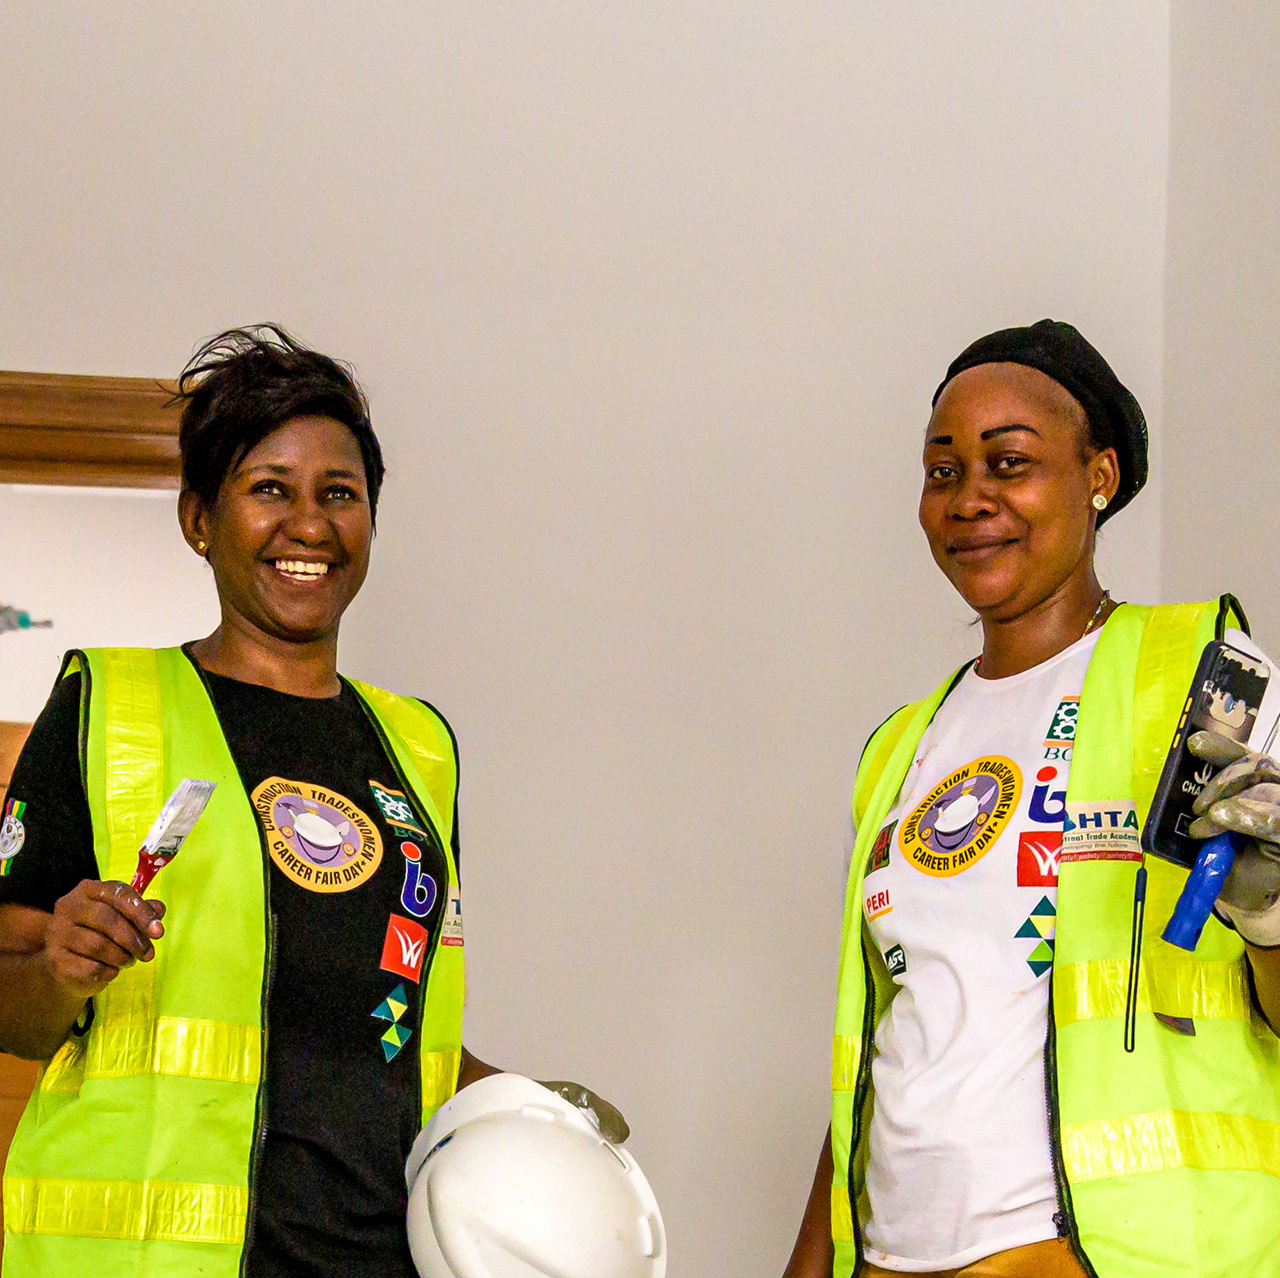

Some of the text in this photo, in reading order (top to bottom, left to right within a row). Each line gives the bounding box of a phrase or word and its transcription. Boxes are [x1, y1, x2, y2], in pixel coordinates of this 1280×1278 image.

[904, 761, 1015, 844] CONSTRUCTION TRADESWOMEN
[1078, 810, 1139, 831] HTA
[310, 790, 376, 861] TRADESWOMEN
[913, 847, 949, 871] CAREER
[952, 848, 977, 868] FAIR
[975, 825, 995, 850] DAY
[273, 840, 364, 885] CAREER FAIR DAY
[866, 888, 890, 914] PERI
